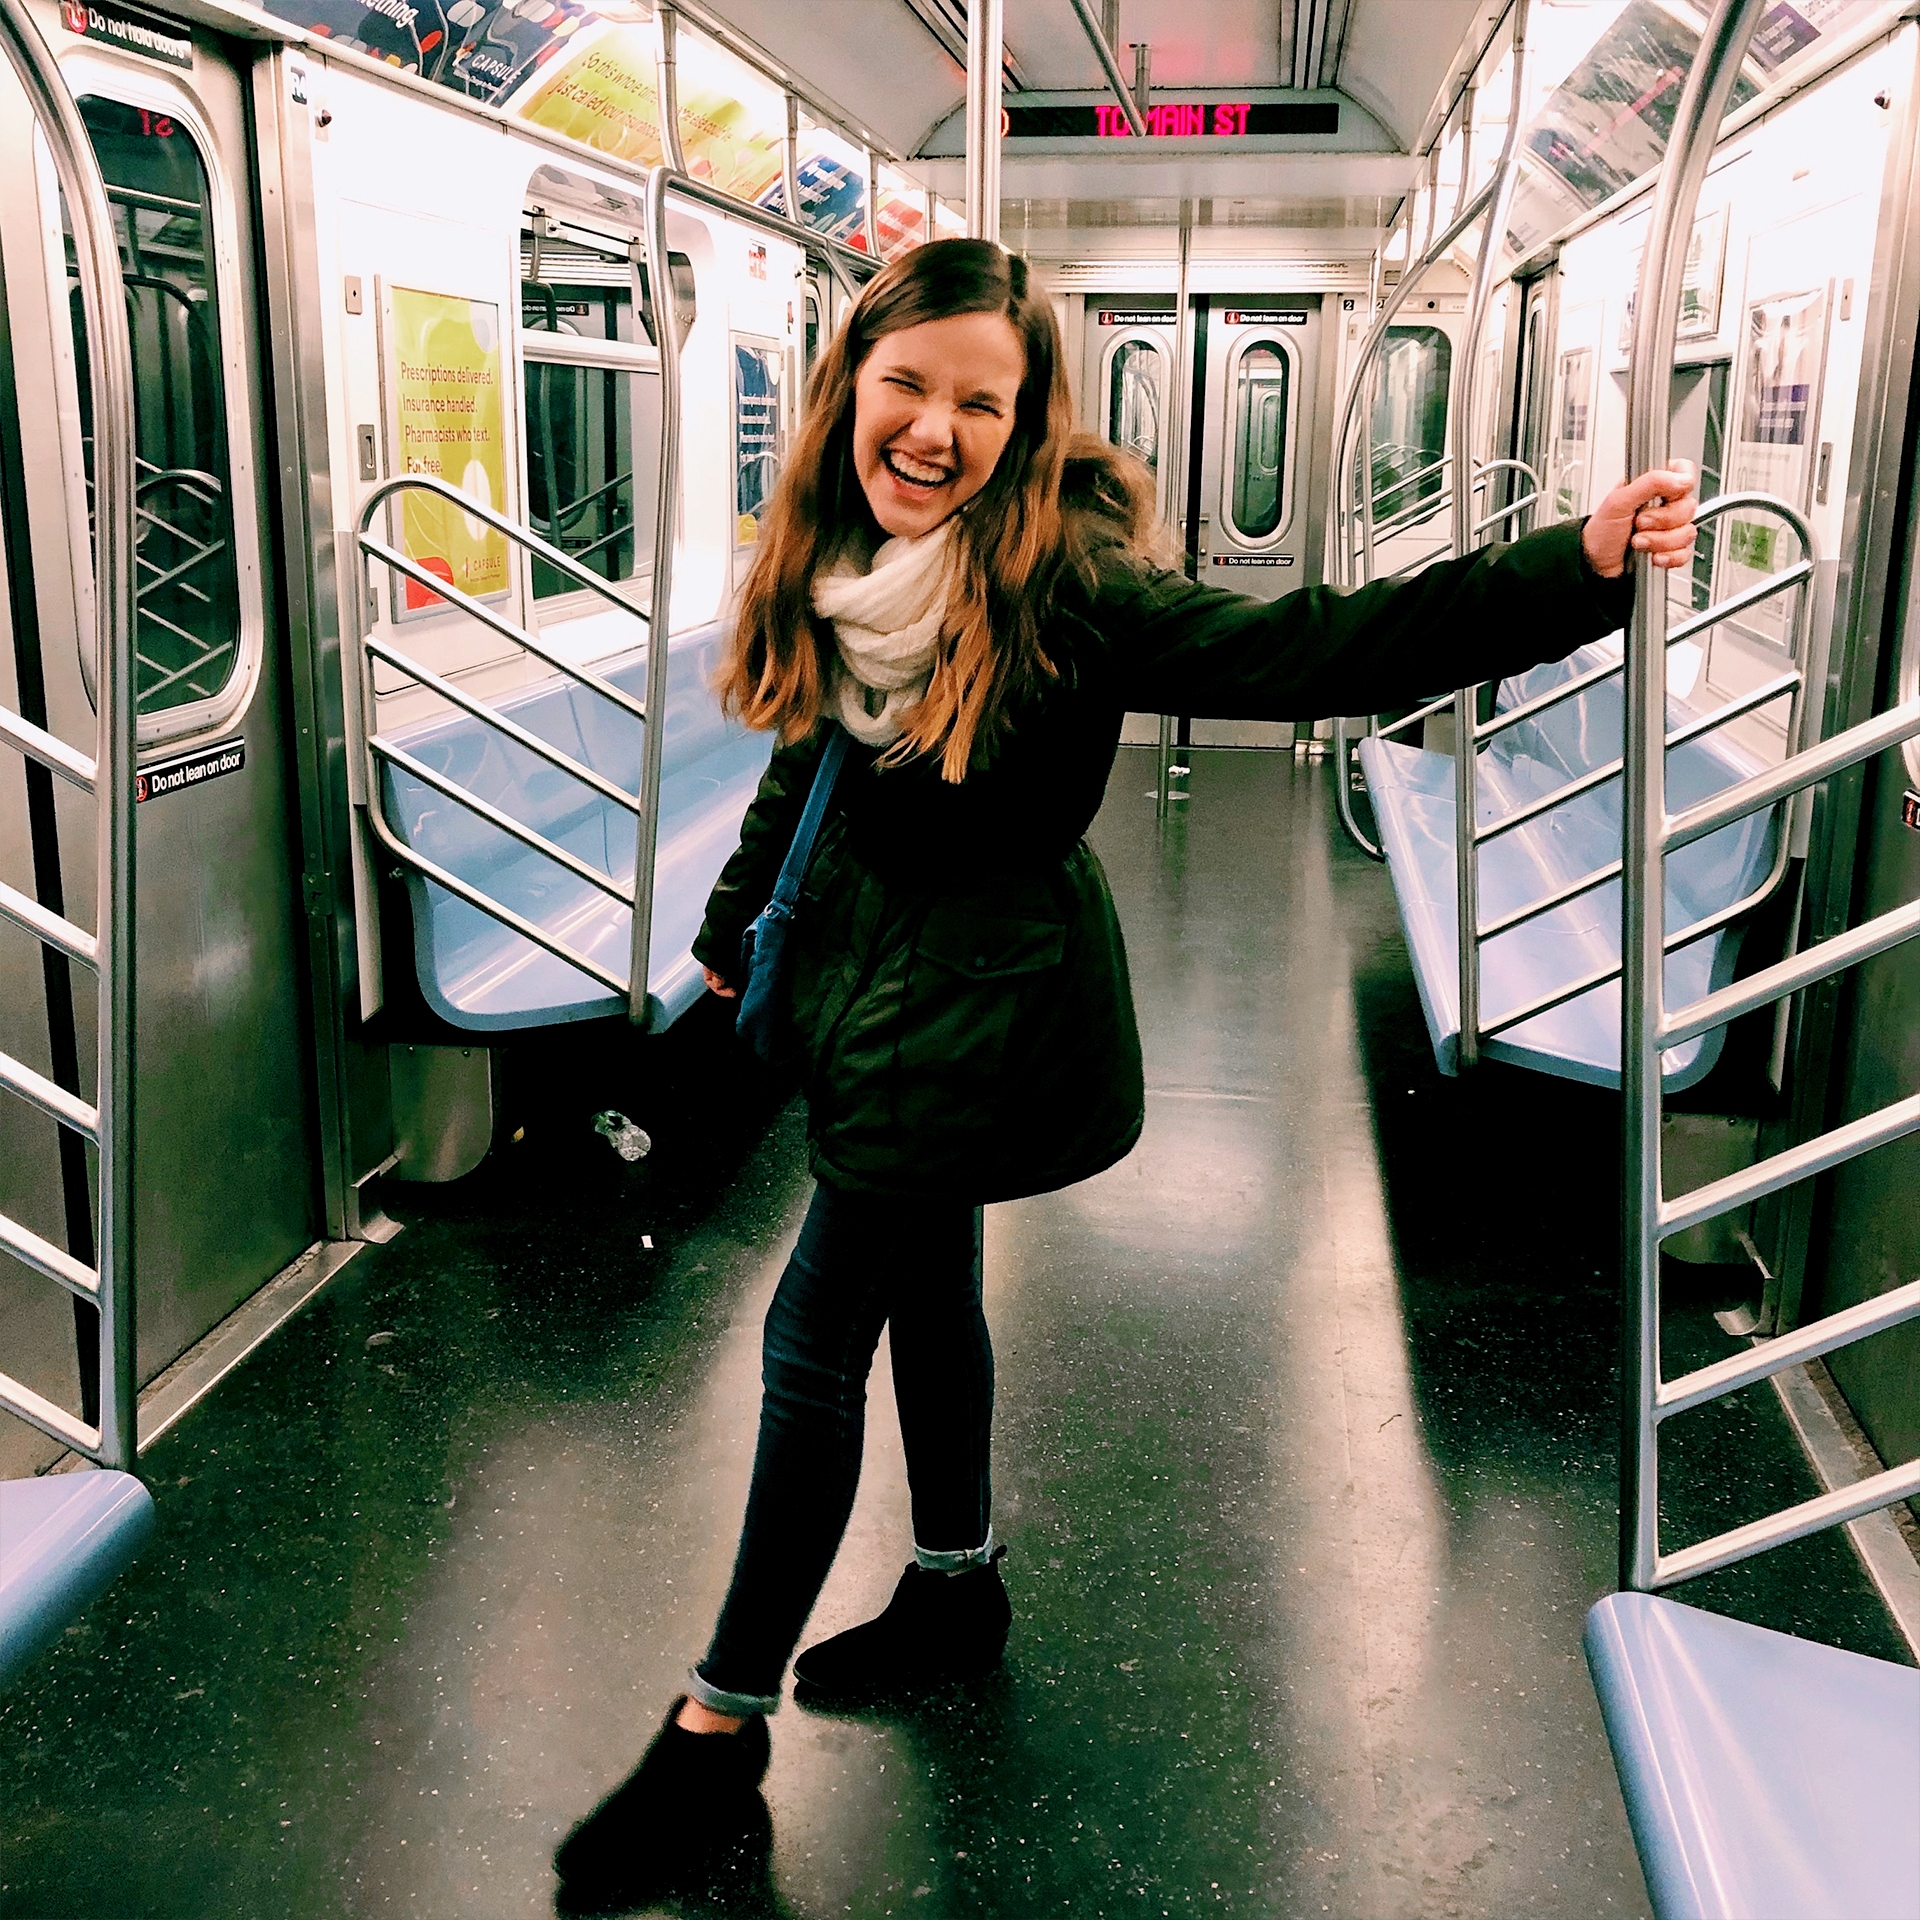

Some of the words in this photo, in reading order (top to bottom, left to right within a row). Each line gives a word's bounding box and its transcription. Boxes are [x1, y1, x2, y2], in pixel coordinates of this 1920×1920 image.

[88, 7, 106, 32] Do
[107, 19, 127, 39] not
[128, 22, 153, 48] hold
[153, 32, 185, 59] doors
[471, 53, 521, 84] CAPSULE
[582, 51, 600, 69] So
[595, 60, 618, 79] this
[612, 72, 643, 93] whole
[547, 75, 580, 97] just
[571, 89, 609, 110] called
[594, 102, 624, 120] your
[1095, 105, 1131, 137] TO
[1214, 103, 1251, 136] ST
[1344, 300, 1353, 310] 2
[1114, 314, 1124, 322] Do
[1136, 315, 1151, 323] lean
[1161, 315, 1176, 323] door
[1240, 314, 1250, 322] Do
[1250, 314, 1262, 322] not
[1263, 314, 1278, 322] lean
[1287, 314, 1304, 322] door
[401, 361, 456, 385] Prescriptions
[457, 366, 493, 385] delivered.
[403, 393, 445, 412] Insurance
[446, 395, 477, 413] handled.
[405, 424, 456, 442] Pharmacists
[456, 425, 472, 442] who
[473, 427, 490, 442] text.
[422, 455, 443, 473] free.
[1239, 557, 1250, 565] not
[151, 775, 167, 793] Do
[167, 768, 185, 788] not
[185, 764, 206, 782] lean
[206, 760, 219, 775] on
[220, 753, 241, 771] door
